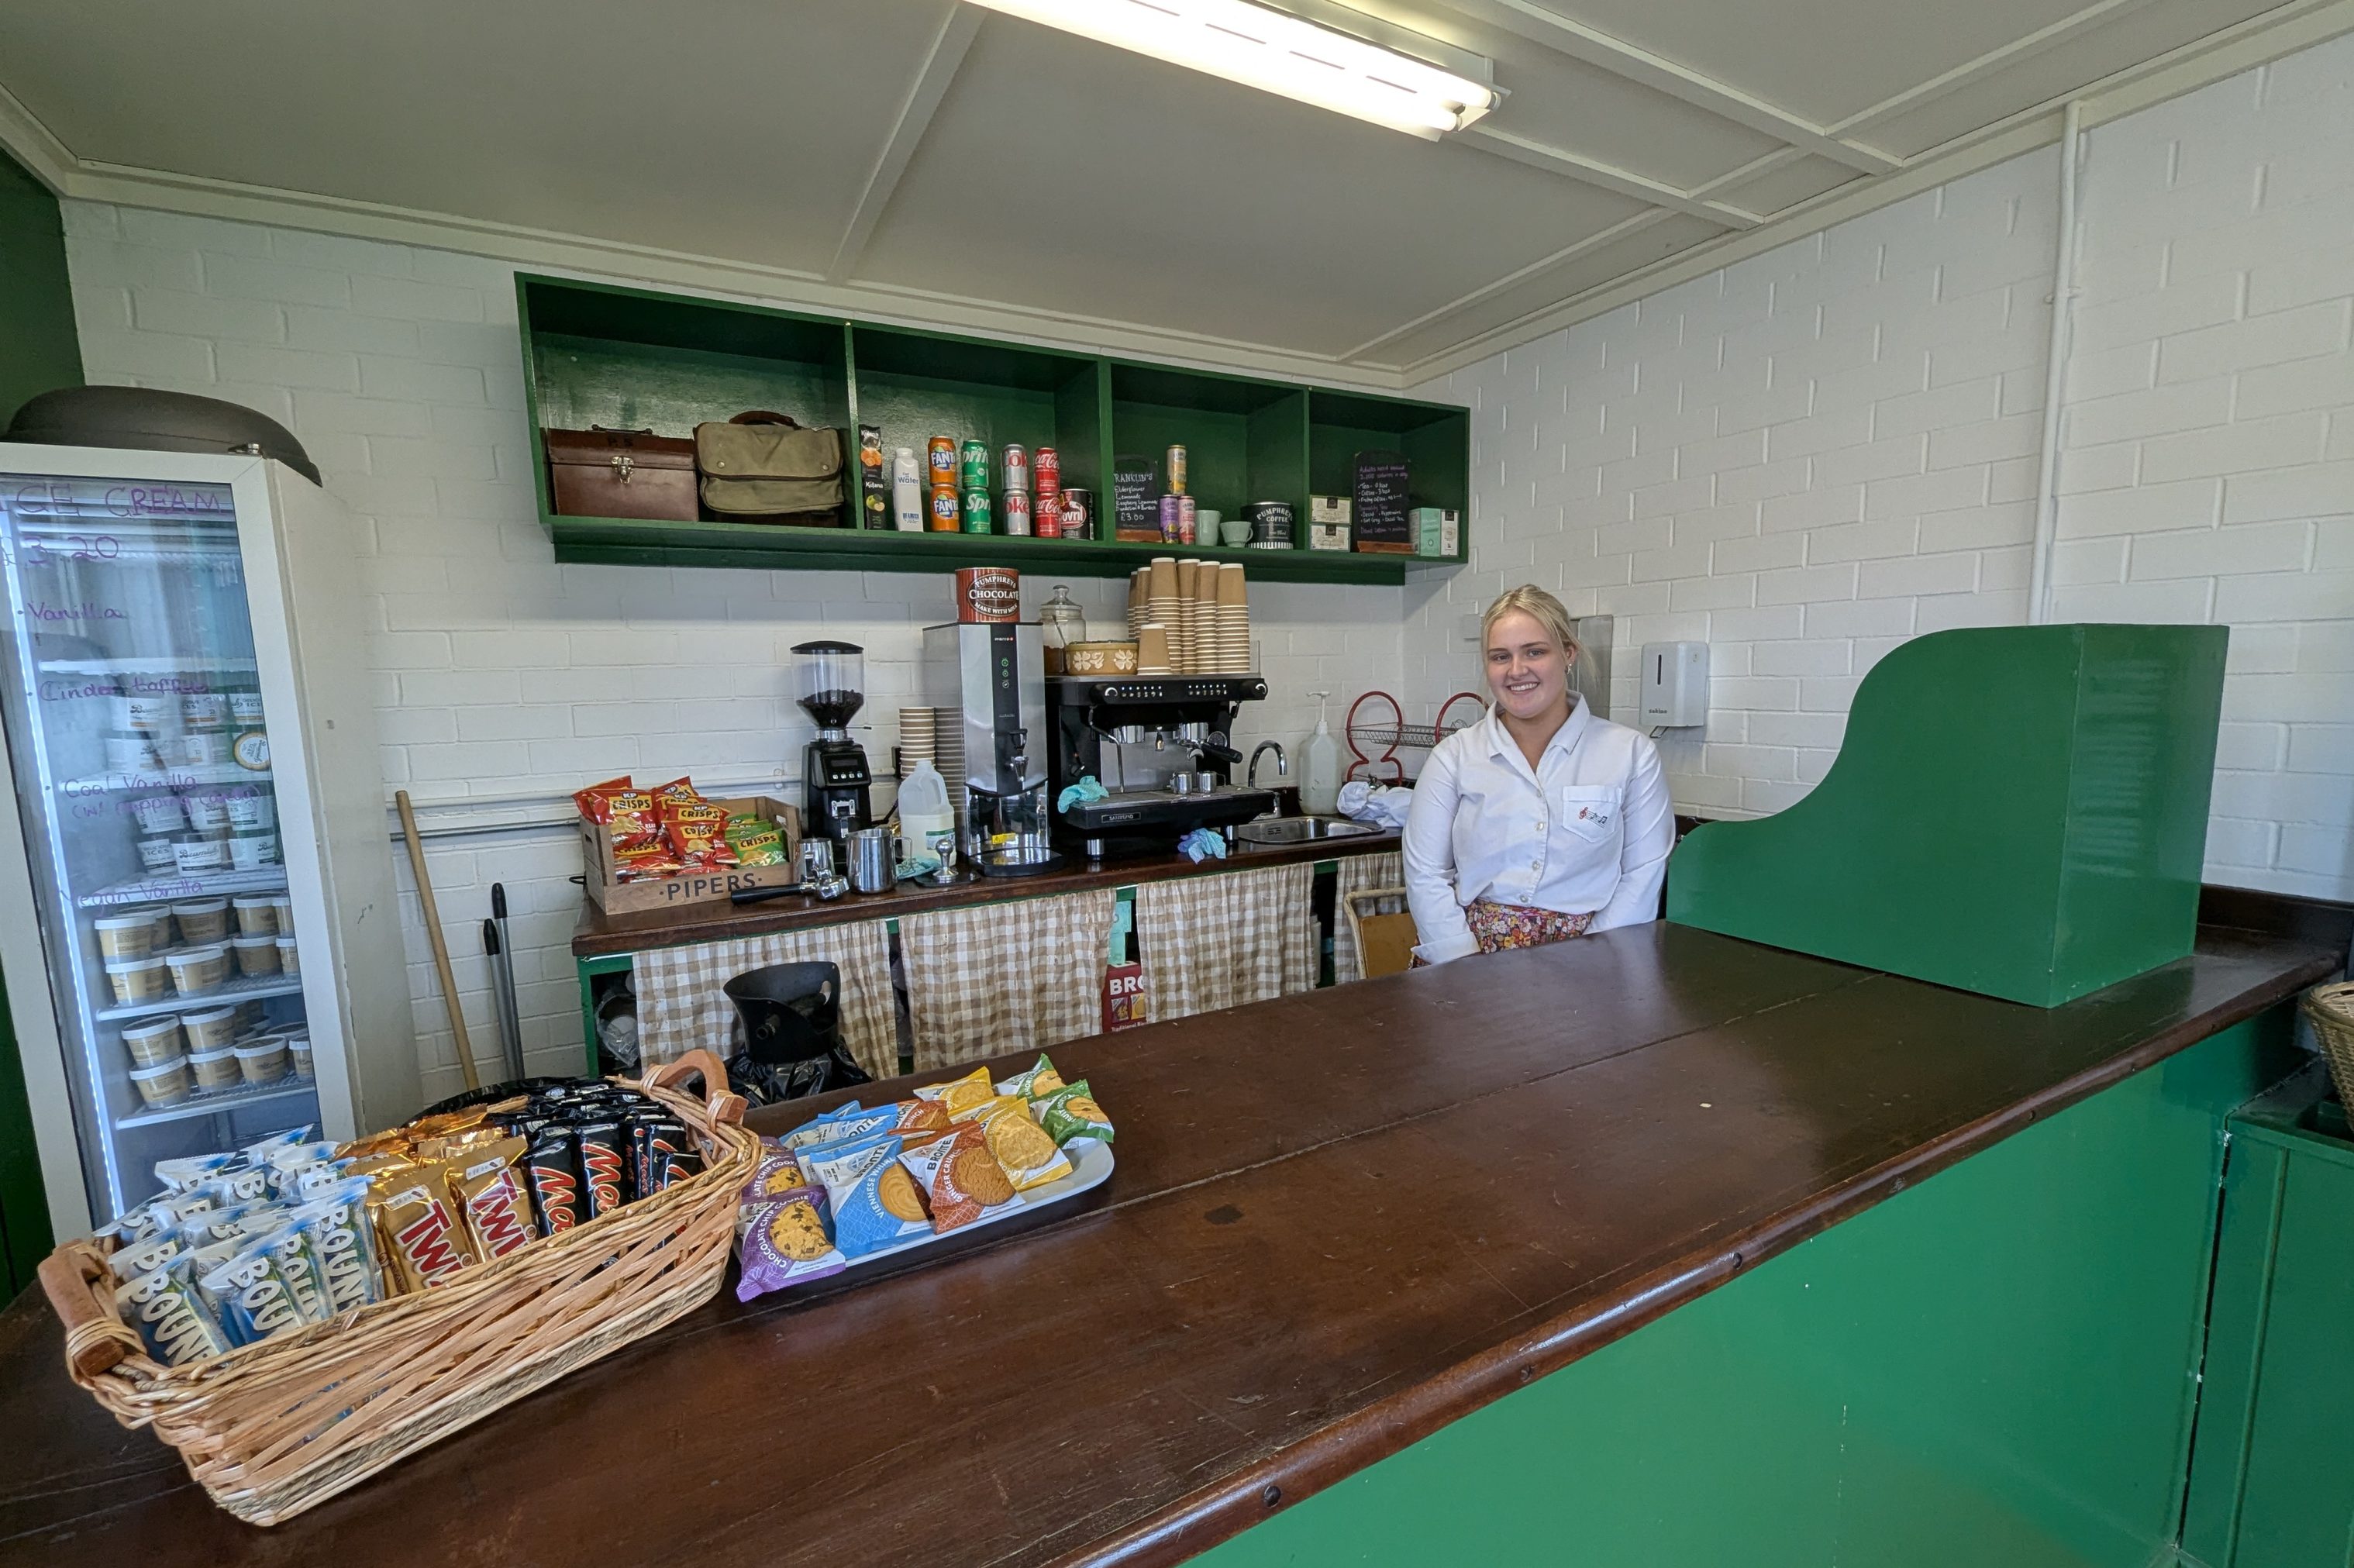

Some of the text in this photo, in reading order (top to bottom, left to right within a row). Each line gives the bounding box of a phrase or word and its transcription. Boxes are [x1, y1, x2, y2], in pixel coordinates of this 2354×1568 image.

[105, 484, 229, 518] CREAM
[1121, 512, 1144, 521] £3.00
[969, 590, 1019, 600] CHOCOLATE
[974, 602, 991, 613] MAKE
[612, 799, 650, 810] CRISPS
[681, 810, 718, 818] CRISPS
[740, 836, 777, 847] CRISPS
[667, 872, 756, 901] PIPERS
[904, 1108, 924, 1129] CRUNCH
[1059, 1109, 1077, 1122] FRUIT
[757, 1166, 772, 1181] CHIP
[943, 1148, 963, 1202] GINGER CRUNCH
[867, 1156, 896, 1218] VIENNESE WHIRL
[760, 1210, 774, 1227] CHIP
[758, 1226, 788, 1267] CHOCOLATE
